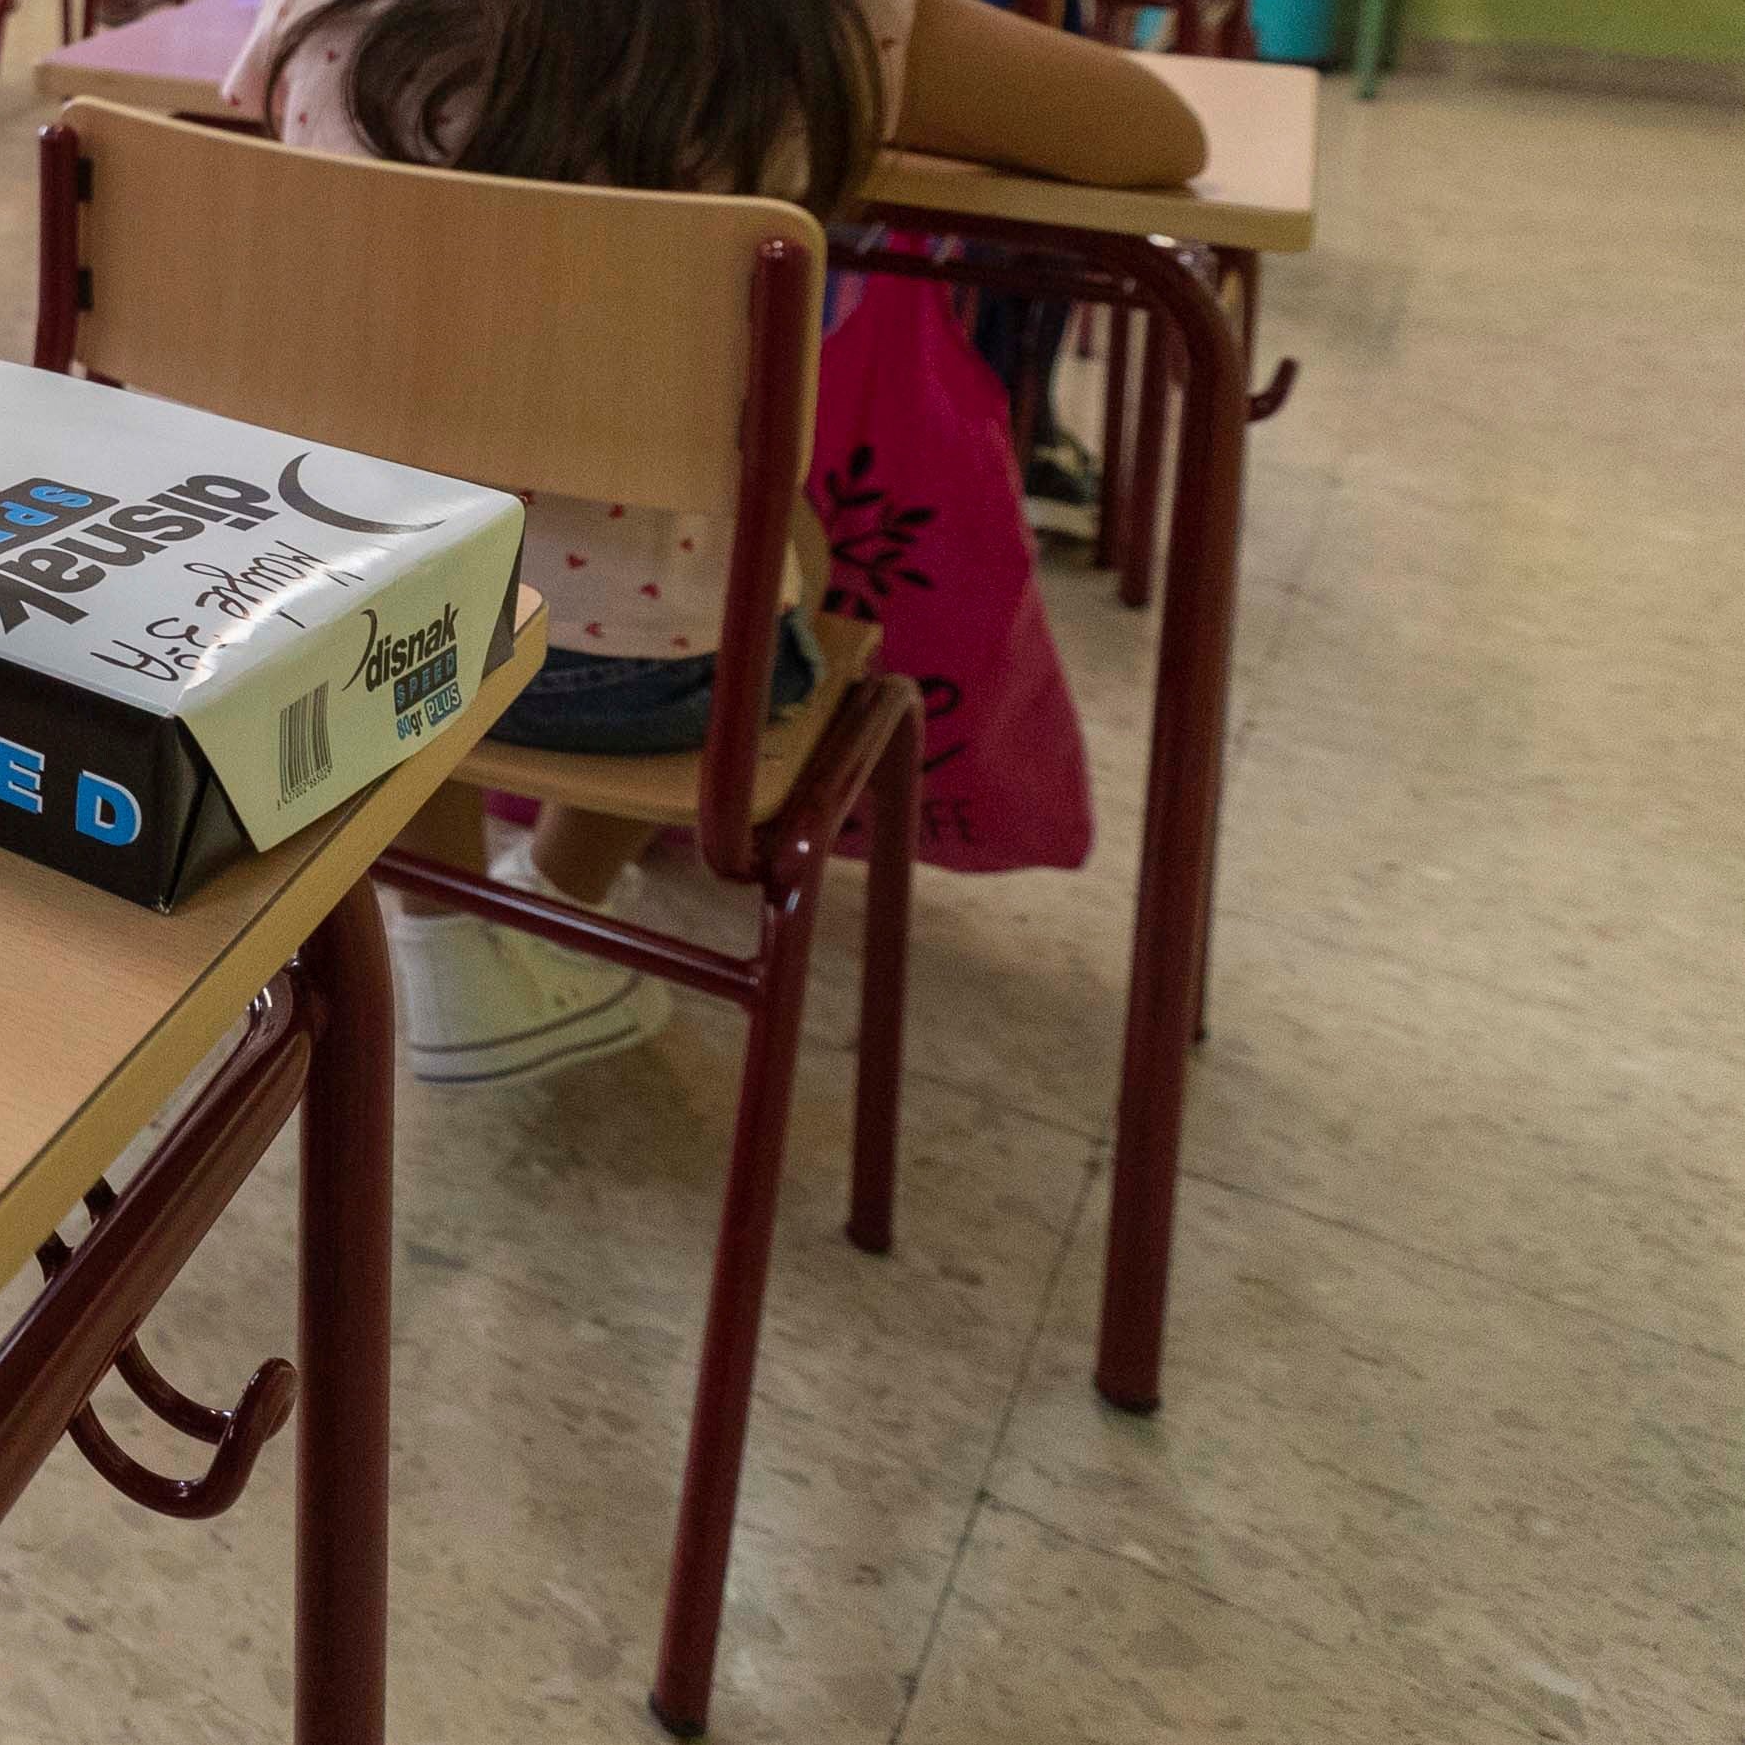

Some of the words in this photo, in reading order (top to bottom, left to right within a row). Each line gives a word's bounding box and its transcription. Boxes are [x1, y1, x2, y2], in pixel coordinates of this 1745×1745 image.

[364, 601, 460, 693] disnak
[395, 651, 456, 707] SPEED
[396, 708, 423, 741] 80gr
[427, 682, 461, 721] PLUS
